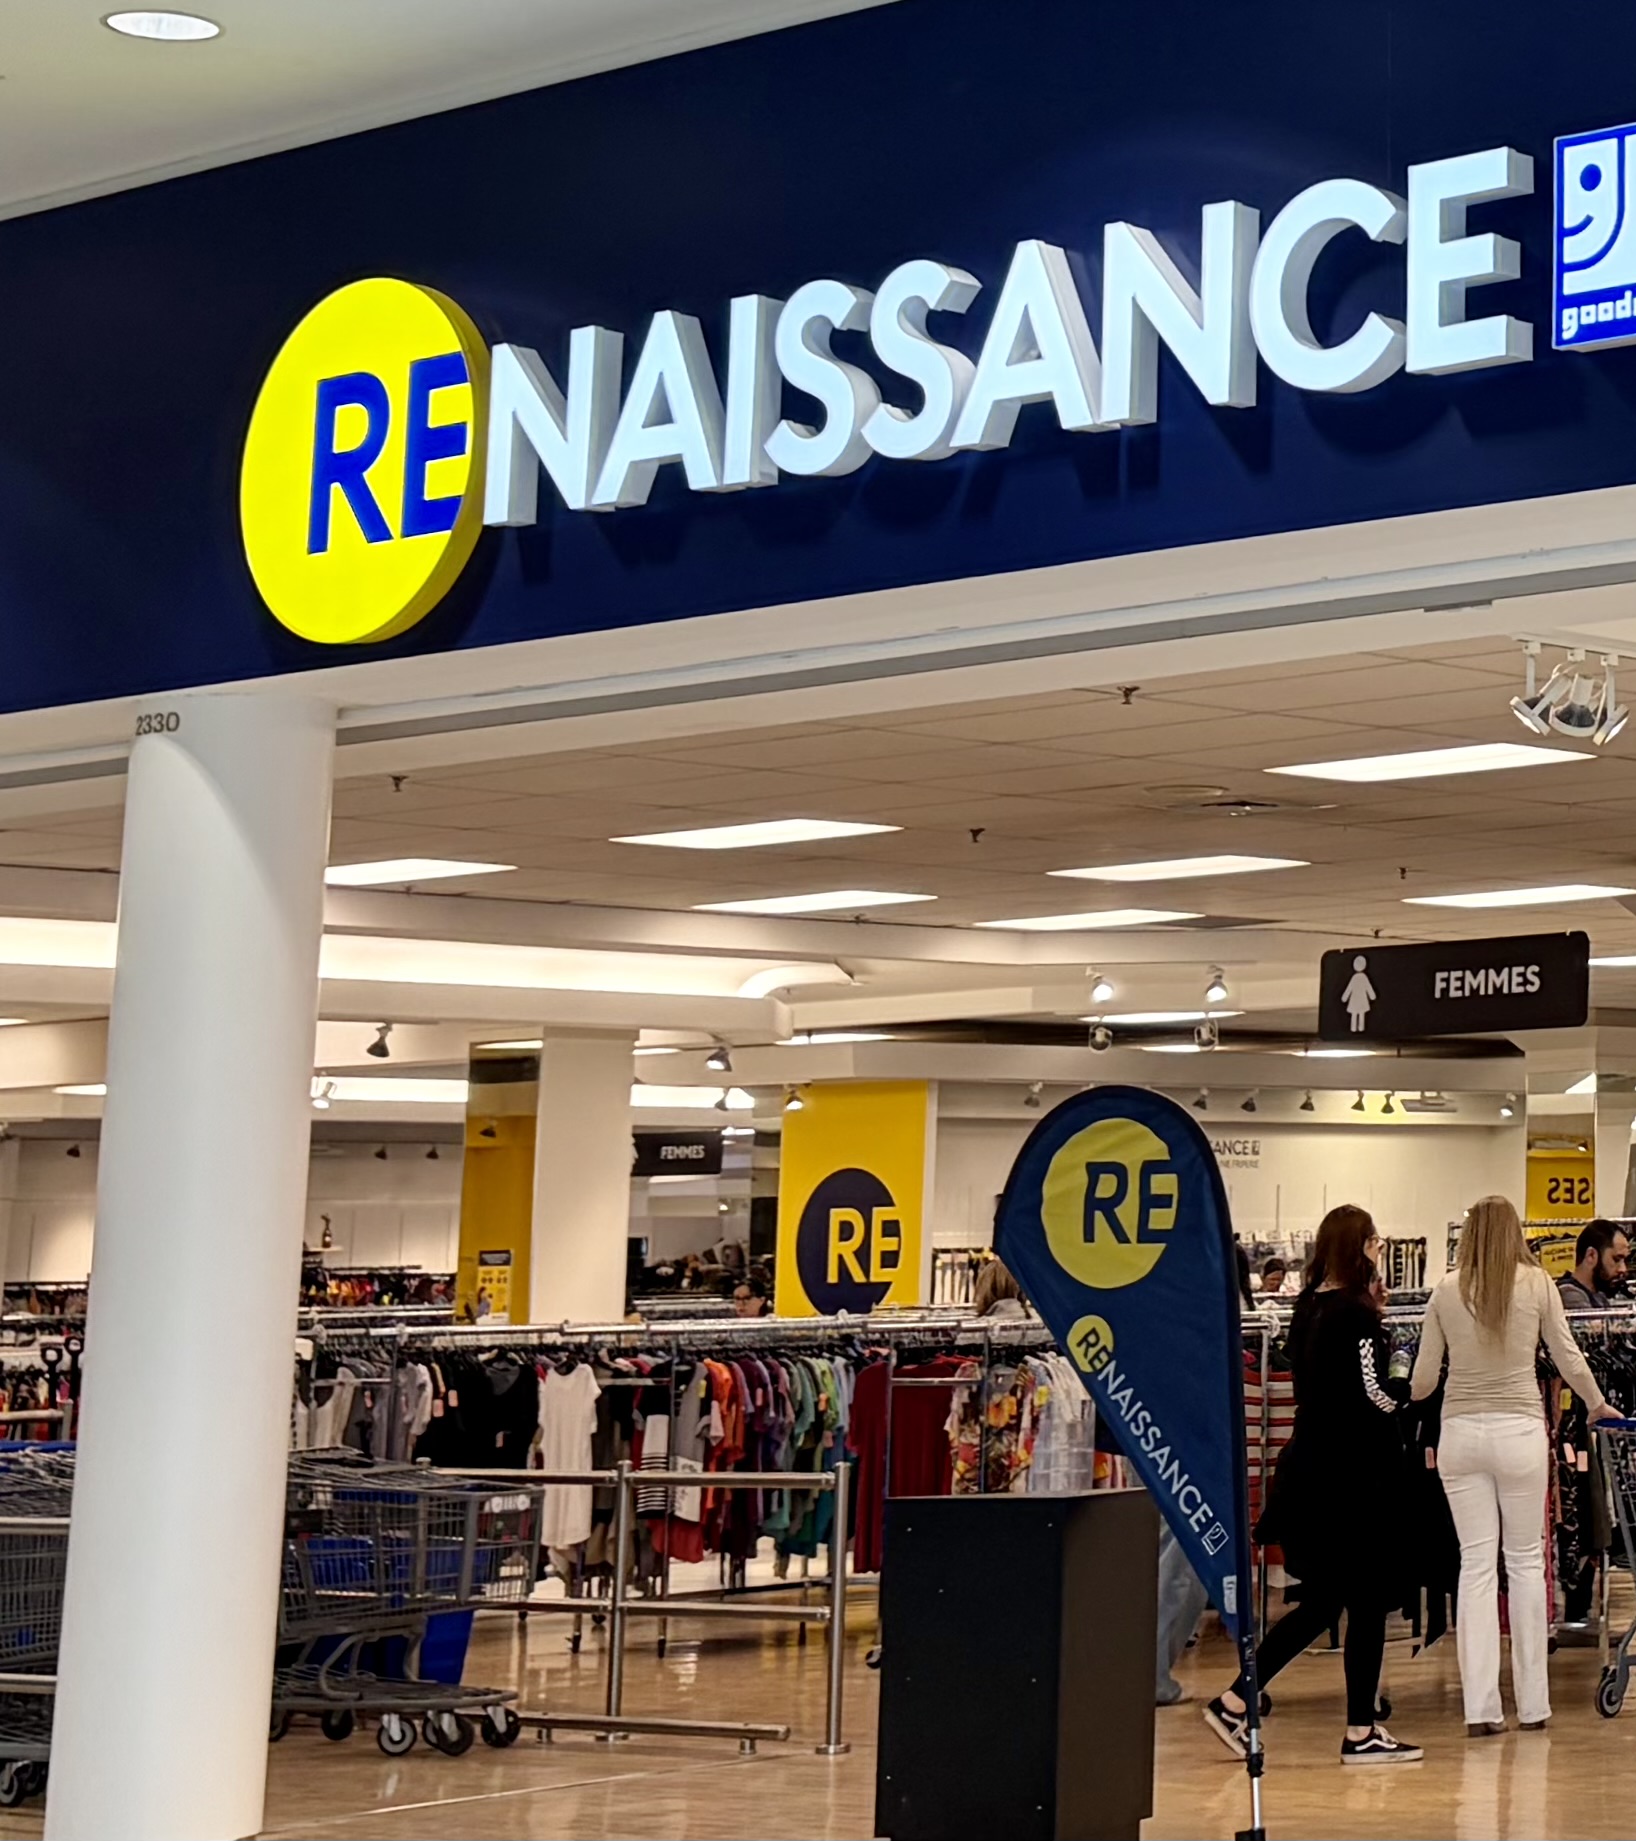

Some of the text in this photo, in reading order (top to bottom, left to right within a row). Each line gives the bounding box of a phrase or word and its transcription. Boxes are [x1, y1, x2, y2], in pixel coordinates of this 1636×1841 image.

[306, 145, 1534, 556] RENAISSANCE
[1434, 964, 1541, 999] FEMMES
[660, 1145, 705, 1159] FEMMES
[1083, 1160, 1174, 1244] RE
[826, 1206, 899, 1284] RE
[1076, 1327, 1213, 1533] RENAISSANCE
